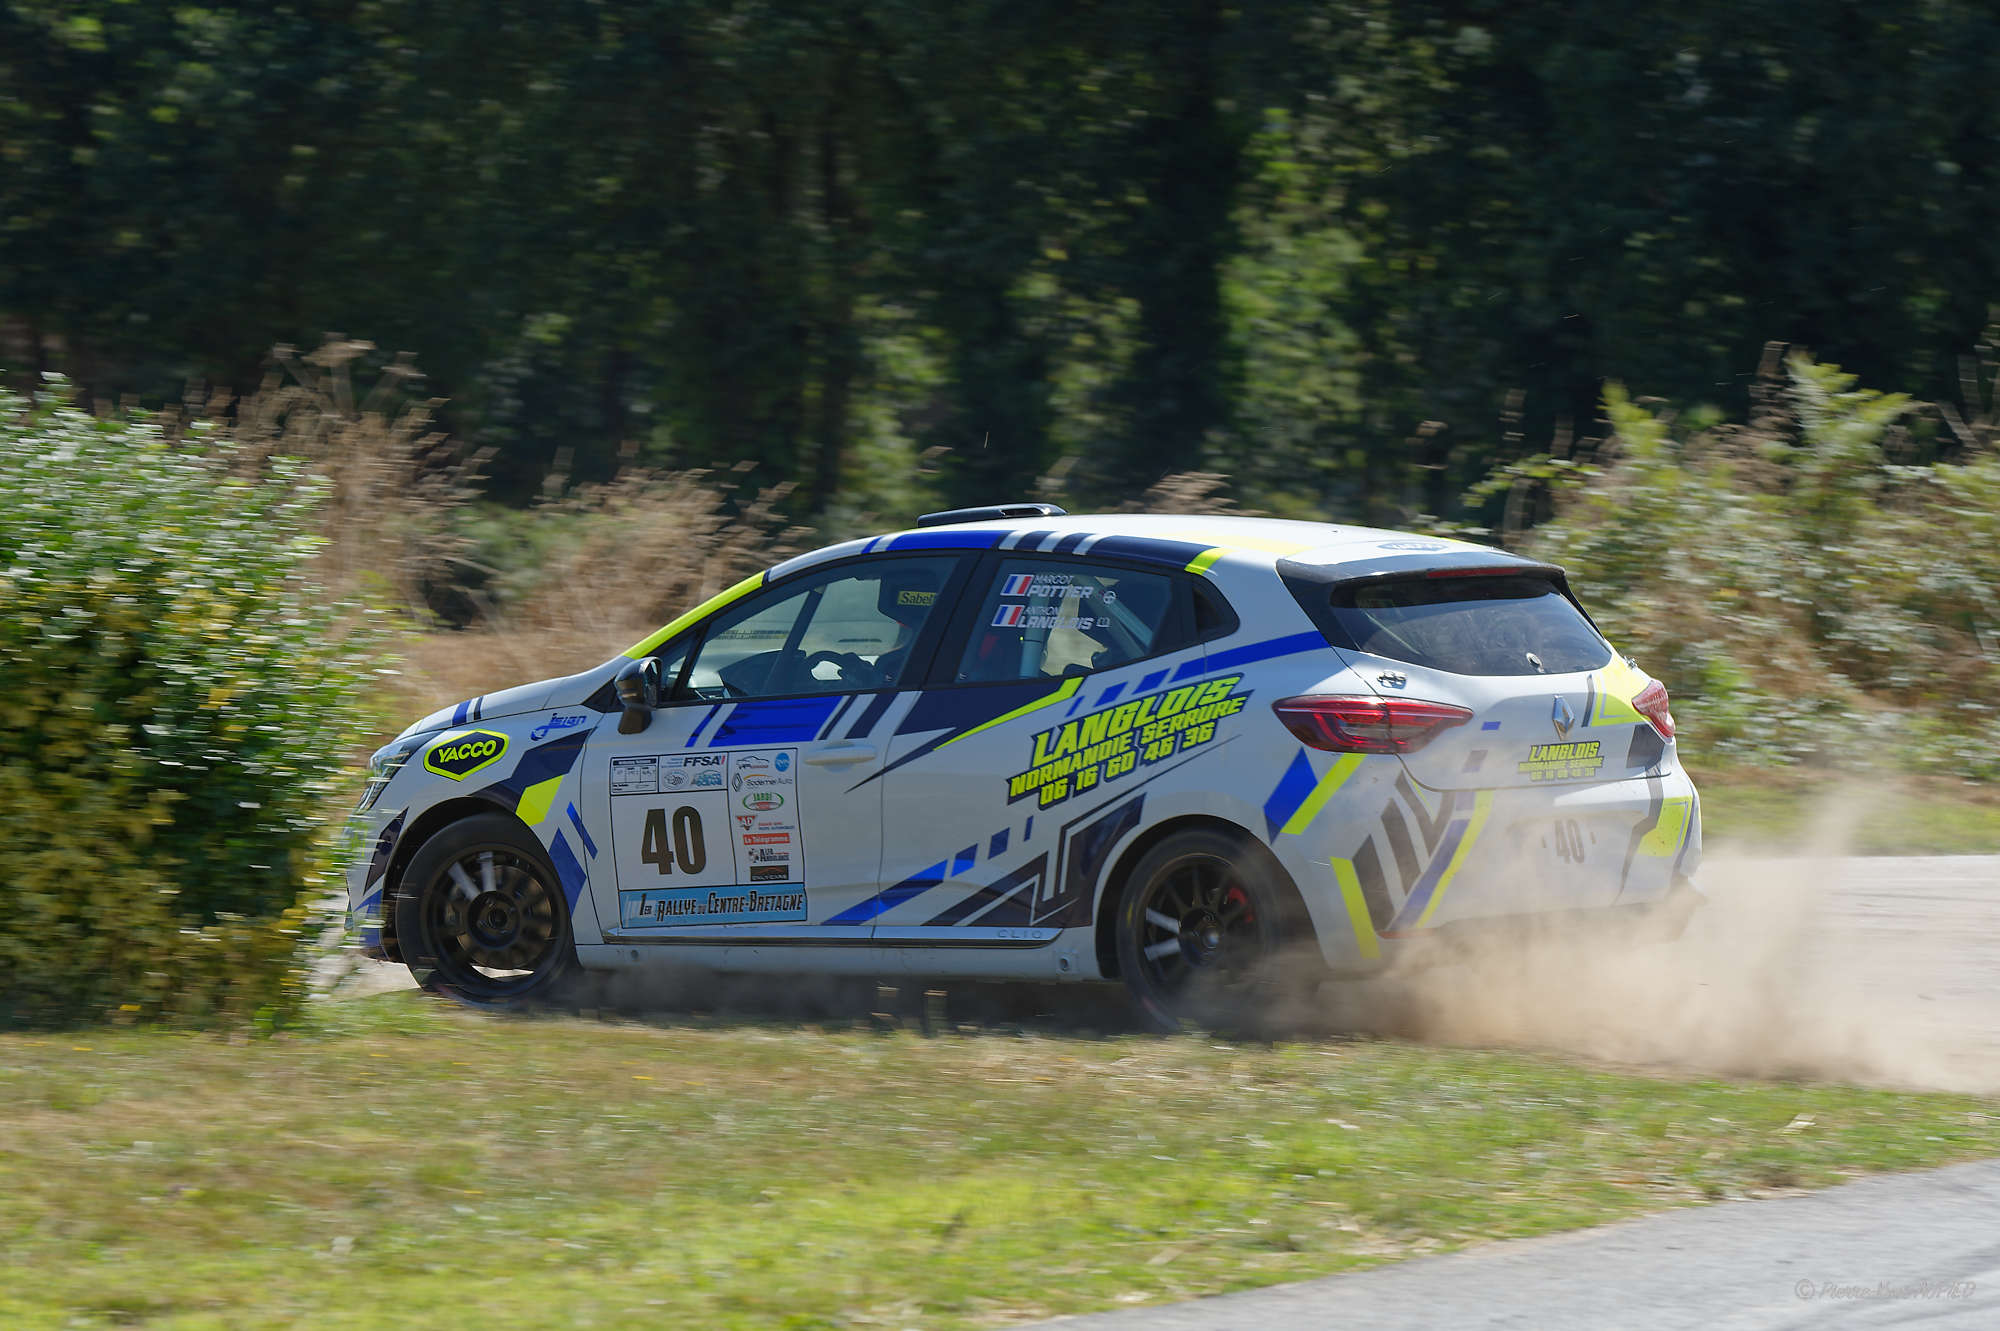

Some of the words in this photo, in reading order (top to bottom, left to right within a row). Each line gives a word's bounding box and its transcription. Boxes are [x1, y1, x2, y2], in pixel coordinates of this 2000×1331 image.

[1026, 585, 1094, 599] POTTIER
[1017, 616, 1095, 630] LANGLOIS
[1031, 676, 1242, 769] LANGLOIS
[438, 740, 497, 764] YACCO
[1009, 731, 1135, 798] NORMANDIE
[1140, 696, 1249, 746] SERRURE
[1528, 741, 1600, 762] LANGLOIS
[683, 755, 721, 767] FFSA
[1039, 778, 1069, 806] 06
[1075, 765, 1098, 791] 16
[1105, 750, 1137, 779] 60
[1142, 736, 1176, 761] 46
[1182, 721, 1216, 749] 36
[641, 806, 706, 875] 40
[1554, 819, 1585, 864] 40
[656, 899, 697, 921] RALLYE
[707, 890, 803, 915] CENTRE-BRETAGNE
[998, 929, 1042, 939] CLIO
